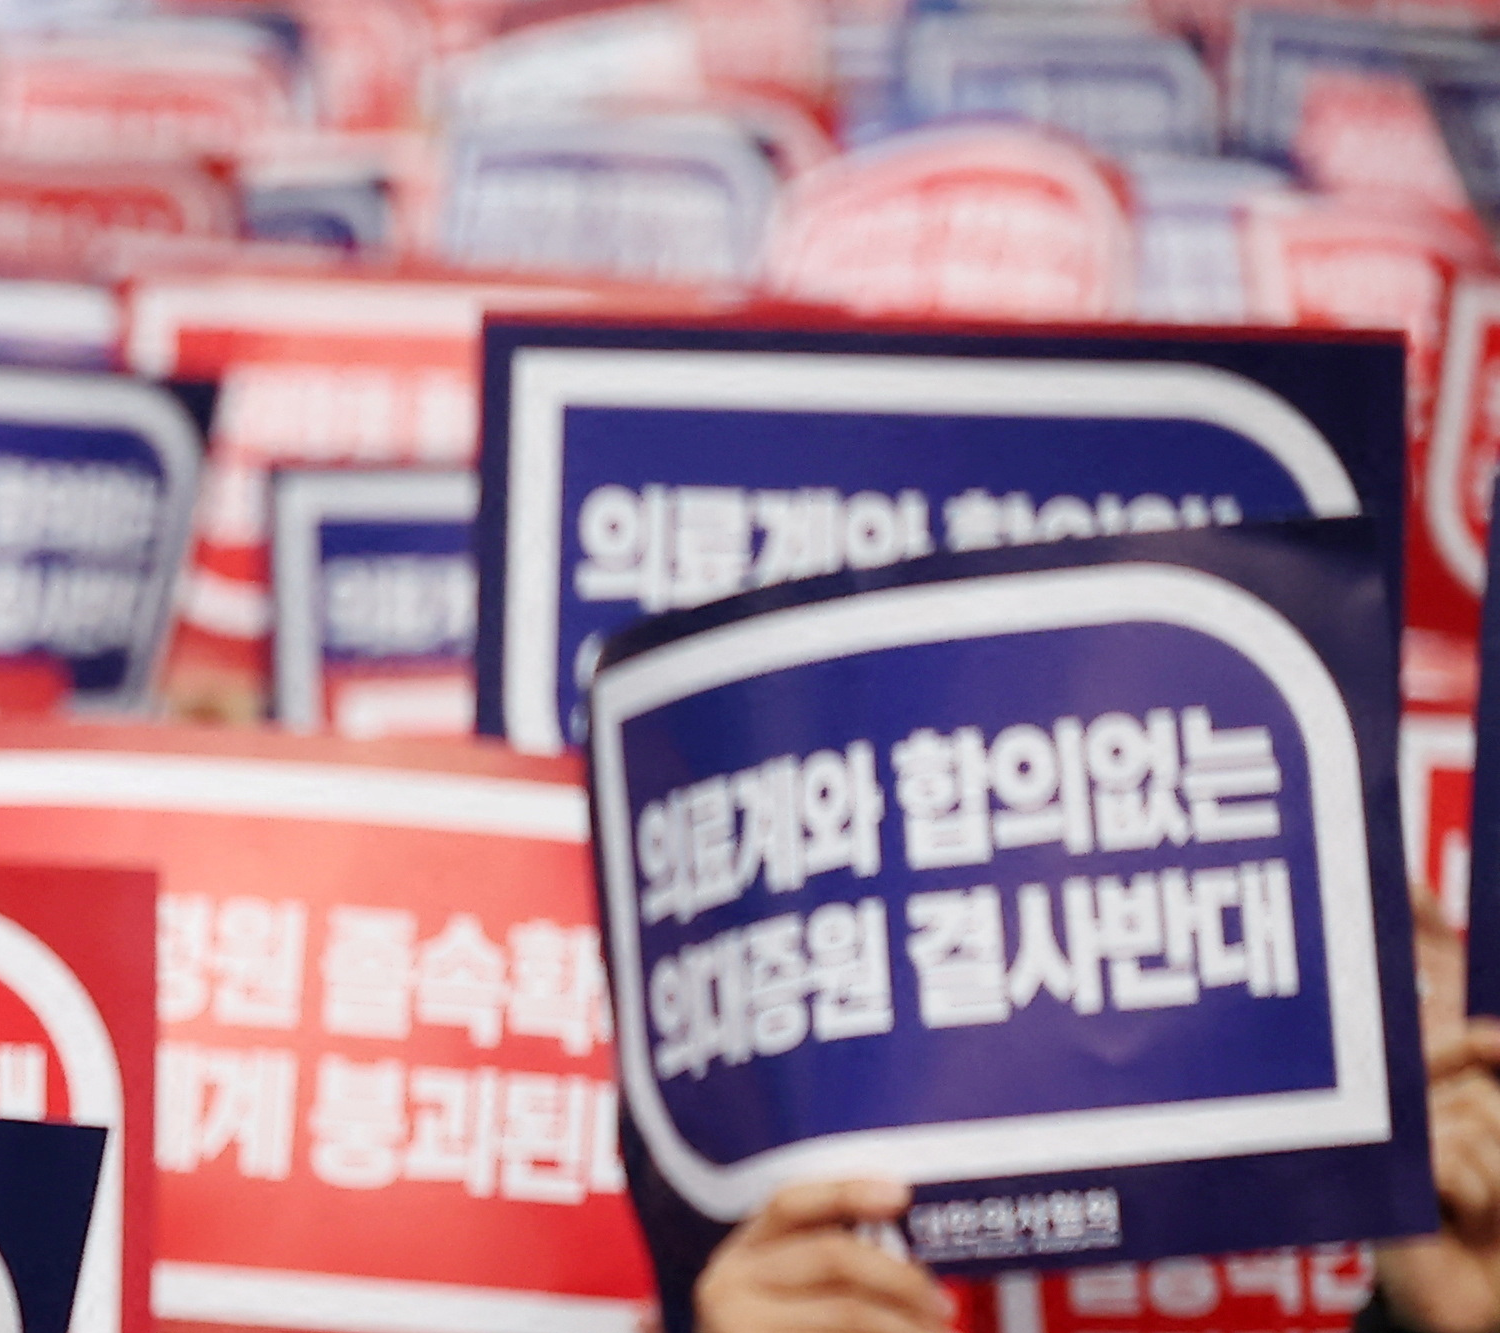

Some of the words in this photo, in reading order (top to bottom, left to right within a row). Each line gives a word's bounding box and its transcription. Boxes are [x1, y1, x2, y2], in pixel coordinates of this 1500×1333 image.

[636, 740, 885, 925] 의료계와
[890, 705, 1285, 872] 합의없는
[320, 905, 616, 1057] 졸속확
[646, 893, 896, 1085] 의대증원
[906, 858, 1302, 1032] 결사반대
[305, 1050, 628, 1206] 붕괴된
